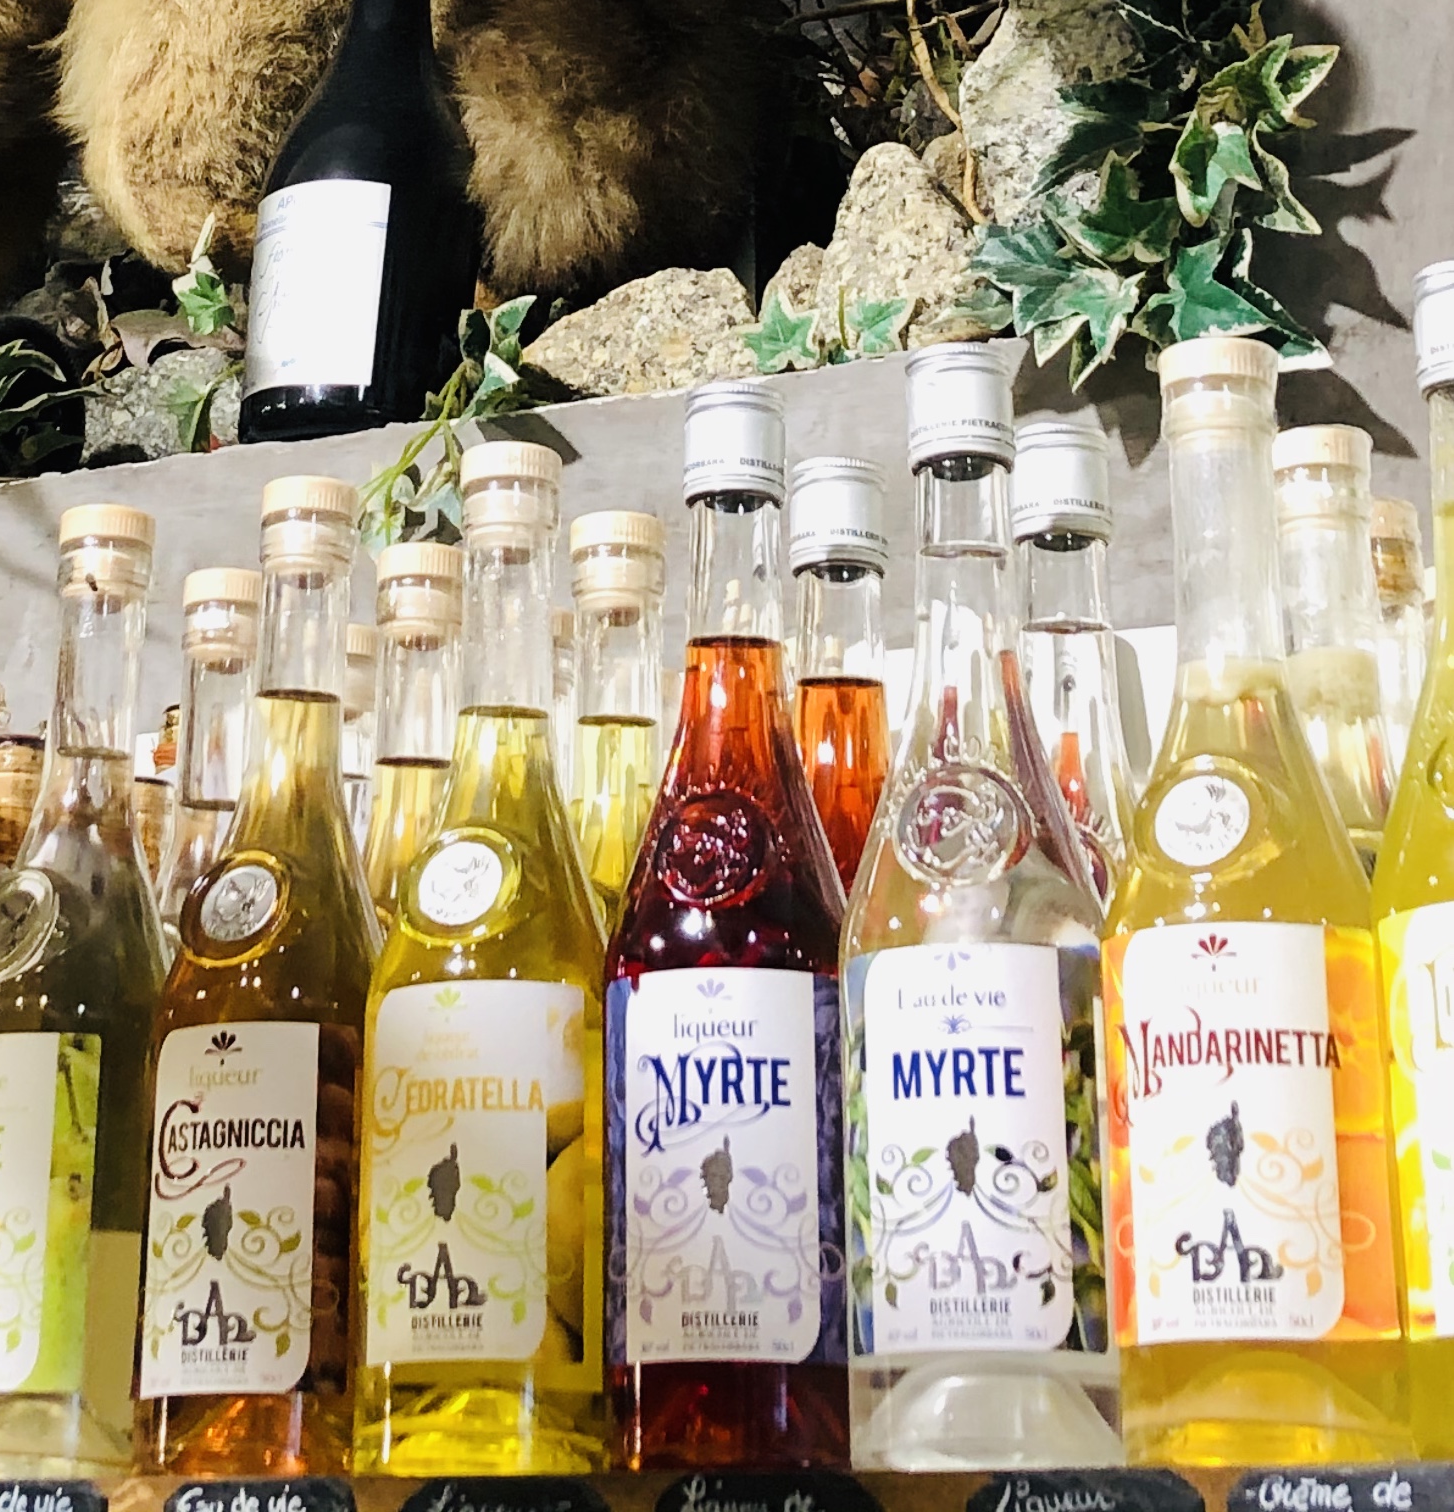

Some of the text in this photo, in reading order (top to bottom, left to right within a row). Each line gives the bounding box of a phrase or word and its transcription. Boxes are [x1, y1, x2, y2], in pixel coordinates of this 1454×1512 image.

[974, 989, 1007, 1008] vie
[673, 1013, 759, 1043] liqueur
[1116, 1006, 1342, 1100] MANDARINETTA
[189, 1066, 263, 1090] liqueur
[892, 1046, 1026, 1101] MYRTE
[635, 1046, 791, 1157] MYRTE
[156, 1095, 305, 1192] CASTAGNICCIA
[929, 1297, 1012, 1316] DISTILLERIE
[1193, 1286, 1276, 1304] DISTILLERIE
[411, 1312, 484, 1330] DISTILLERIE
[681, 1311, 760, 1328] DISTILLERIE
[181, 1346, 249, 1364] DISTILLERIE
[34, 1487, 73, 1512] vie
[231, 1486, 260, 1512] de
[268, 1484, 307, 1512] vie
[1372, 1470, 1413, 1509] de
